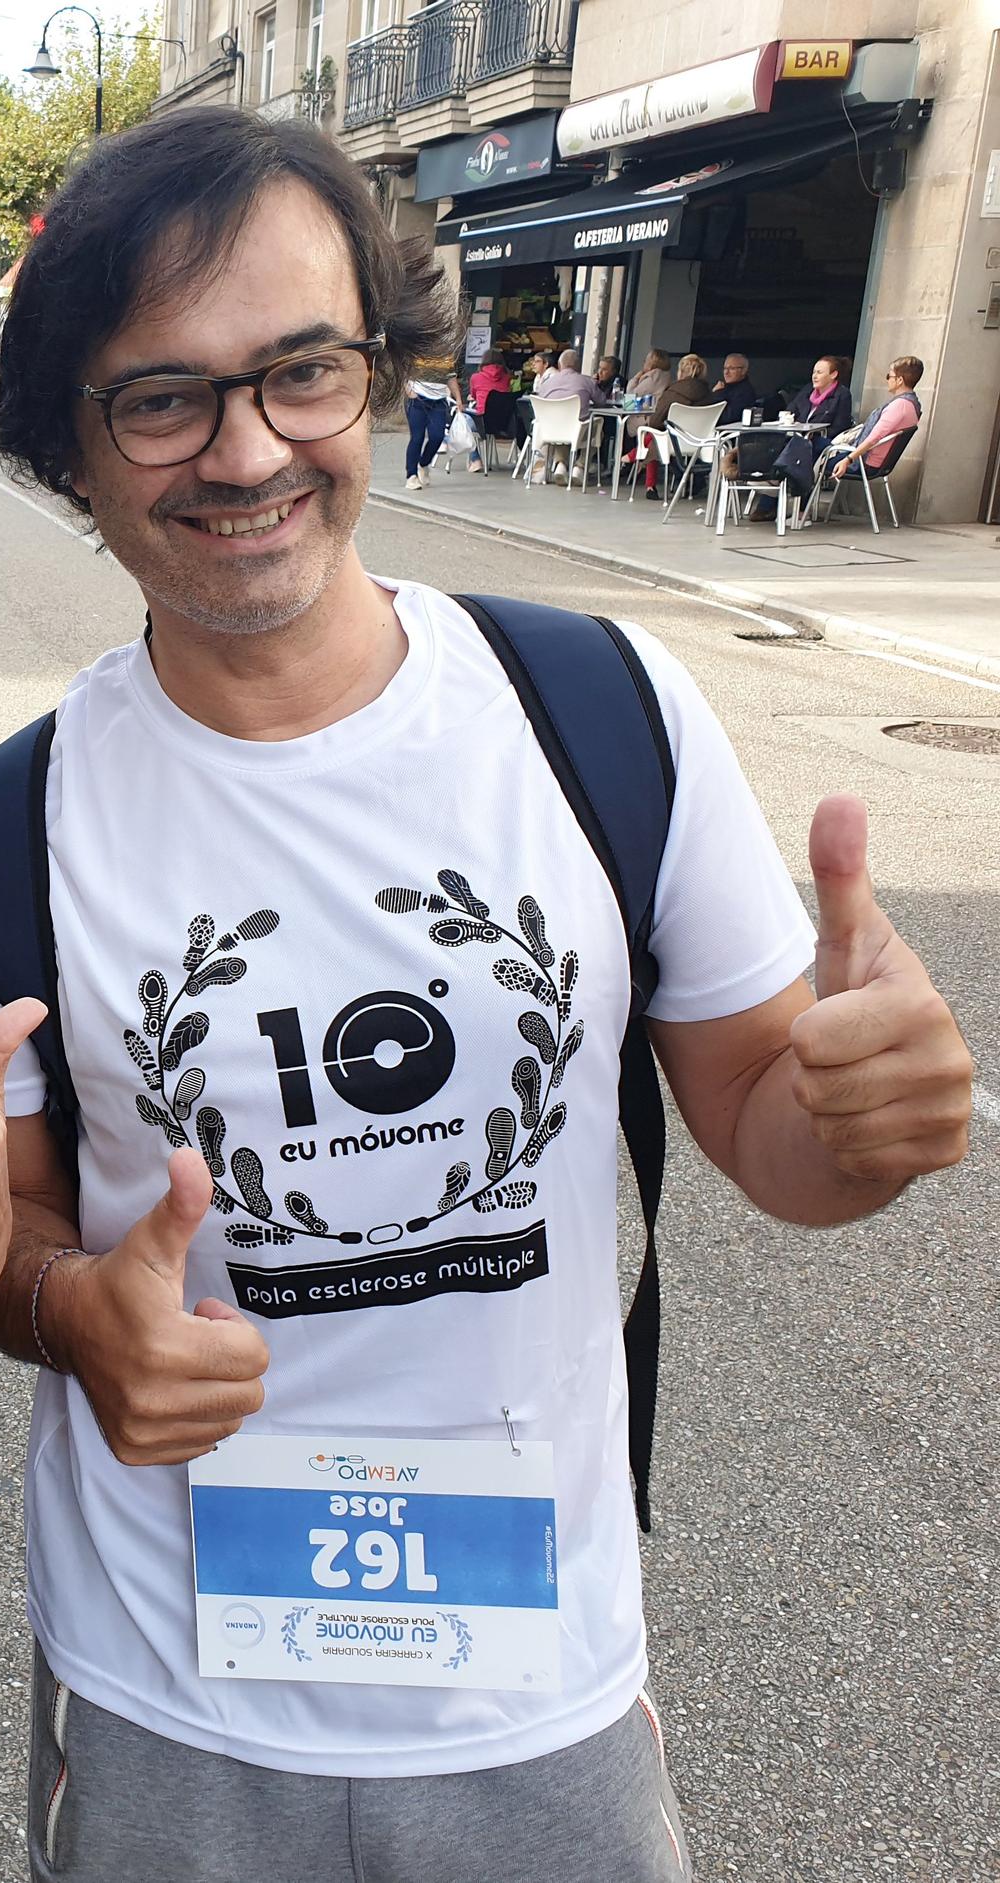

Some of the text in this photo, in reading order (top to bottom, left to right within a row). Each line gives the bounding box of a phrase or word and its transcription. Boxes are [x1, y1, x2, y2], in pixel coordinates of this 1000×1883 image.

[794, 50, 839, 69] BAR
[574, 218, 669, 250] CAFETERIA VERANO
[279, 1117, 465, 1163] eu móvome
[308, 1270, 427, 1301] esclerose
[438, 1249, 536, 1284] múltiple
[338, 1465, 419, 1482] AVEMPO
[329, 1494, 407, 1525] Jose
[308, 1528, 438, 1592] 162
[225, 1621, 258, 1630] ANDAINA
[317, 1614, 435, 1626] POLA ESCLEROSE MÚLTIPLE
[316, 1623, 438, 1646] EU MÓVOME
[322, 1646, 433, 1660] X CARREIRA SOLIDARIA
